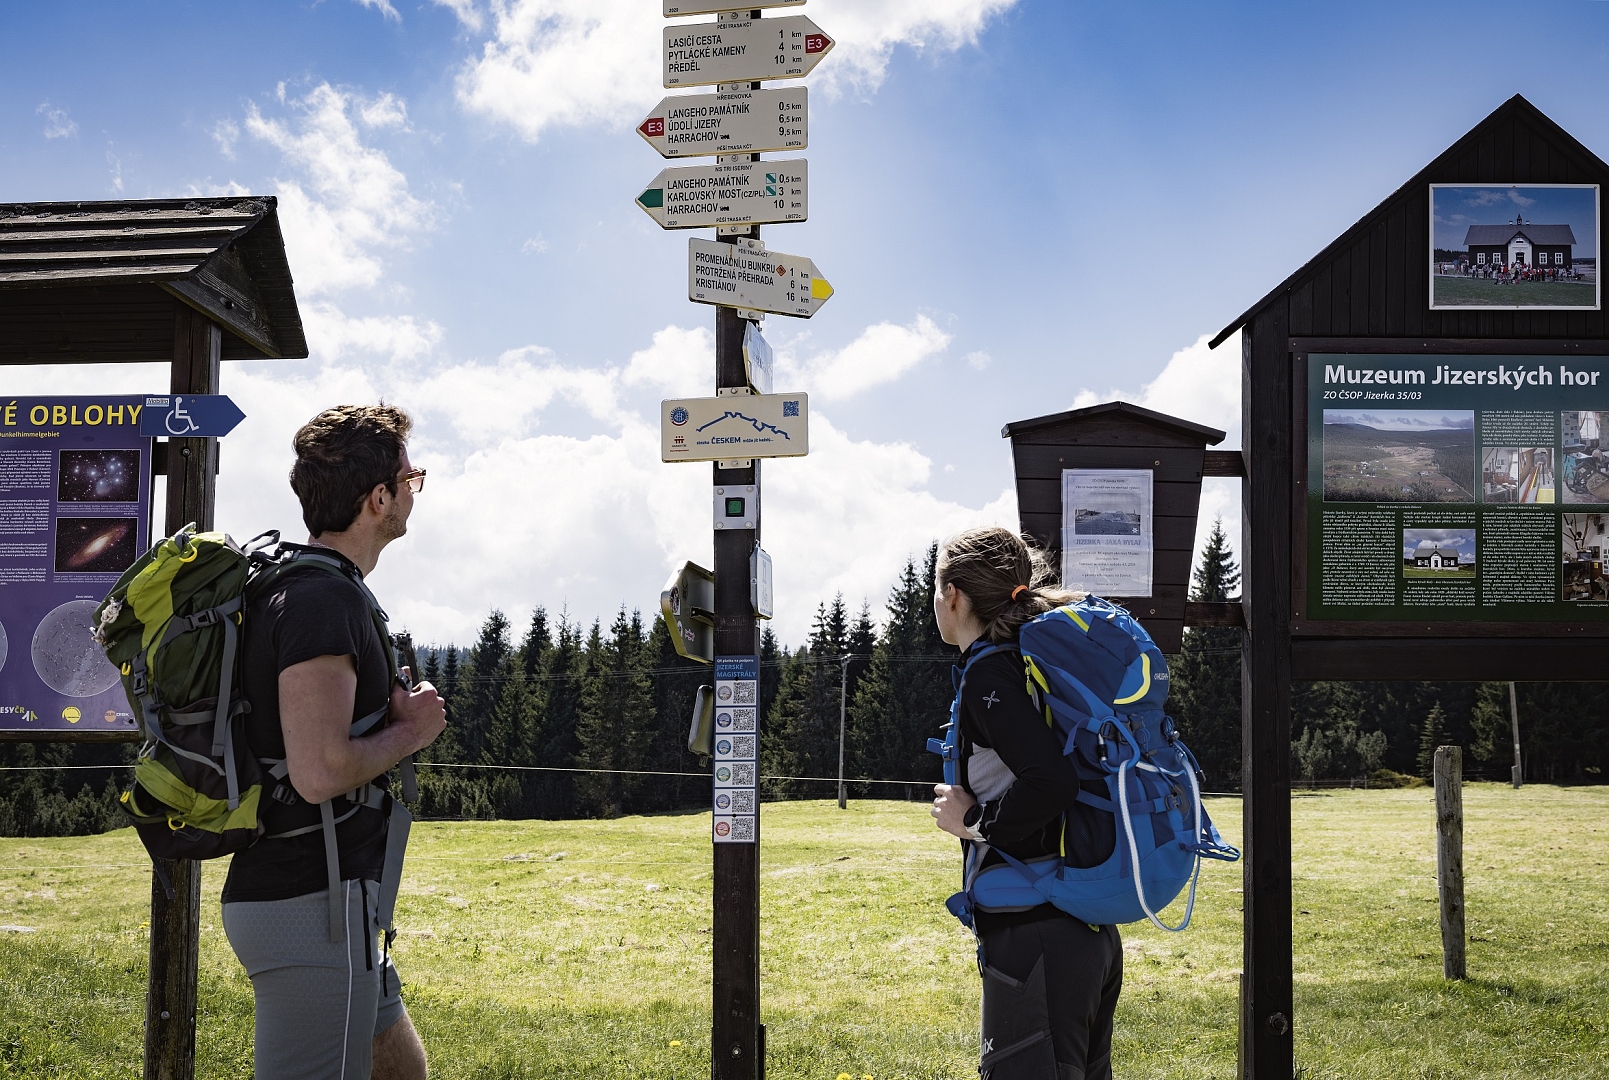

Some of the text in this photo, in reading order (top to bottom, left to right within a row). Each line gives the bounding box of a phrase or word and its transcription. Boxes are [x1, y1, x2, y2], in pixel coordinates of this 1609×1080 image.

[668, 36, 694, 48] LASIČÍ
[696, 35, 722, 46] CESTA
[778, 30, 784, 39] 1
[807, 39, 822, 50] E3
[668, 47, 711, 60] PYTLÁCKÉ
[712, 46, 746, 56] KAMENY
[778, 42, 785, 51] 4
[668, 60, 700, 73] PŘEDĚL
[774, 55, 785, 64] 10
[668, 106, 707, 119] LANGEHO
[709, 103, 750, 116] PAMÁTNÍK
[778, 102, 790, 111] 0,5
[648, 122, 663, 133] E3
[668, 119, 693, 132] ÚDOLÍ
[694, 118, 721, 130] JIZERY
[778, 114, 790, 124] 6,5
[668, 132, 719, 144] HARRACHOV
[778, 127, 790, 137] 9,5
[668, 178, 706, 190] LANGEHO
[708, 174, 750, 187] PAMÁTNÍK
[779, 174, 790, 184] 0,5
[668, 188, 716, 202] KARLOVSKÝ
[778, 187, 784, 196] 3
[668, 203, 719, 215] HARRACHOV
[774, 200, 784, 209] 10
[696, 264, 736, 280] PROTRŽENÁ
[738, 270, 774, 286] PŘEHRADA
[790, 280, 795, 288] 6
[748, 260, 775, 274] BUNKRU
[790, 268, 794, 276] 1
[696, 278, 736, 293] KRISTIÁNOV
[786, 292, 795, 301] 16
[1324, 364, 1600, 391] Muzeum Jizerských hor
[1323, 390, 1422, 400] ZO ČSOP Jizerka 35/03
[30, 404, 142, 426] OBLOHY
[711, 436, 741, 444] ČESKEM
[717, 663, 743, 671] JIZERSKÉ
